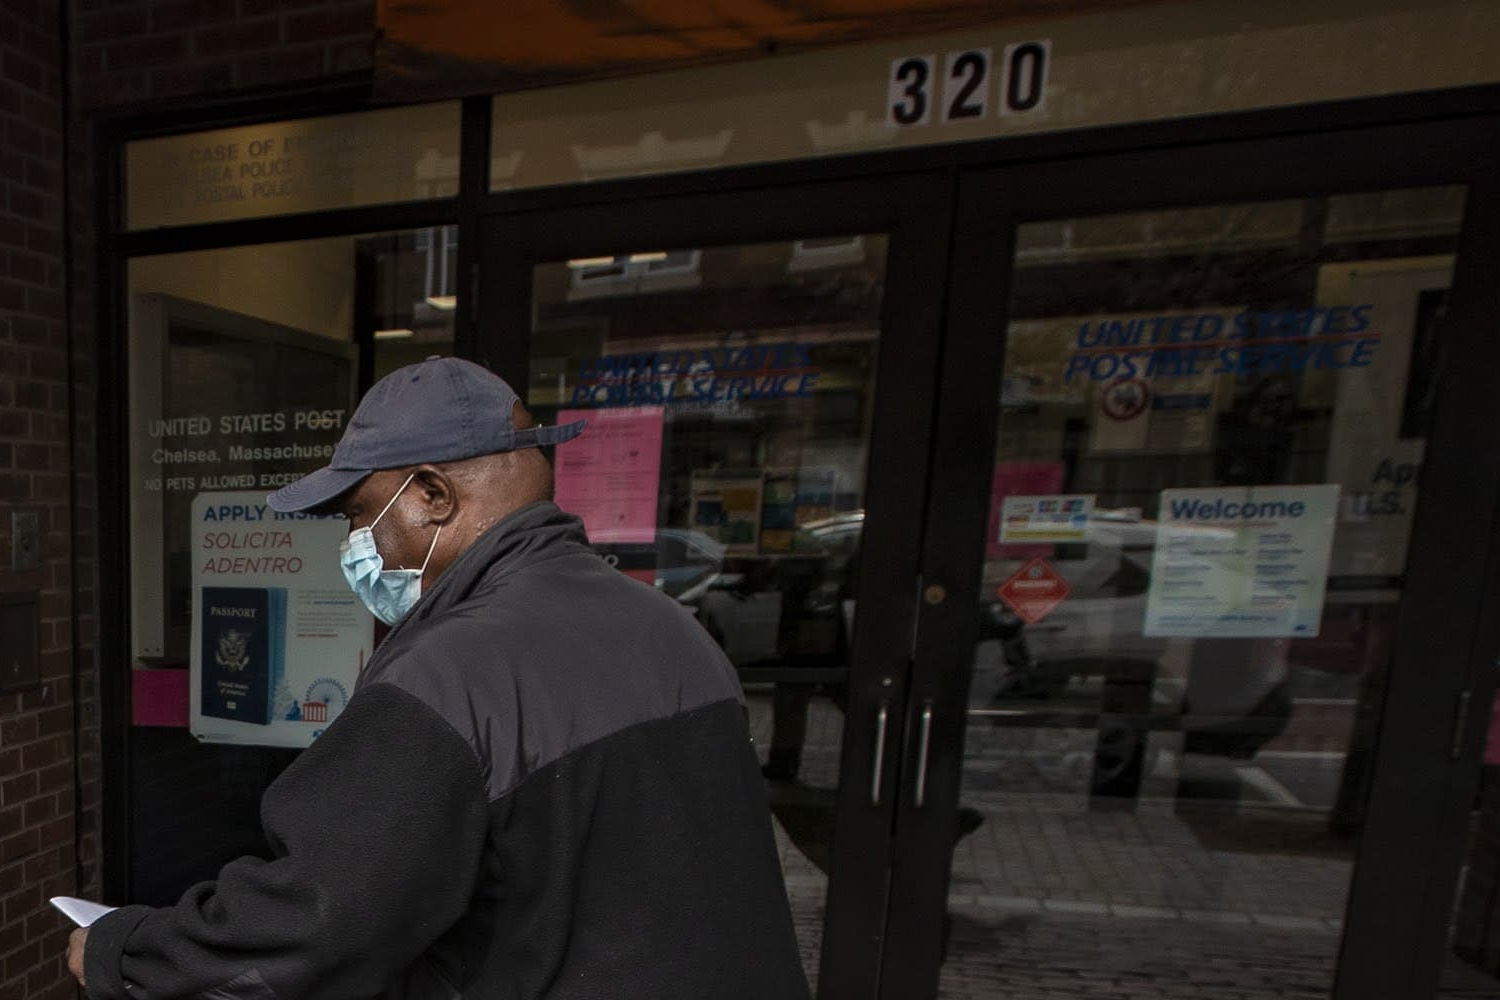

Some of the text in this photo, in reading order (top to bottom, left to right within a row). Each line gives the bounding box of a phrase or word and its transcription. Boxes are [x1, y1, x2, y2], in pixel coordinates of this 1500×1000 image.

[892, 41, 1046, 125] 320
[187, 145, 239, 162] CASE
[247, 139, 275, 158] OF
[239, 158, 294, 178] POLICE
[251, 180, 295, 199] POLIC
[1077, 304, 1374, 349] UNITED STATES
[579, 343, 813, 380] UNITED STATES
[1063, 339, 1381, 384] POSTAL SERVICE
[693, 373, 819, 402] SERVICE
[147, 409, 346, 438] UNITED STATES POST
[151, 441, 337, 465] Chelsea, Massachuse
[144, 478, 162, 491] NO
[166, 476, 195, 490] PETS
[199, 473, 256, 490] ALLOWED
[203, 505, 268, 522] APPLY
[1170, 498, 1306, 520] Welcome
[202, 531, 293, 549] SOLICITA
[201, 556, 303, 574] ADENTRO
[210, 605, 258, 619] PASSPORT
